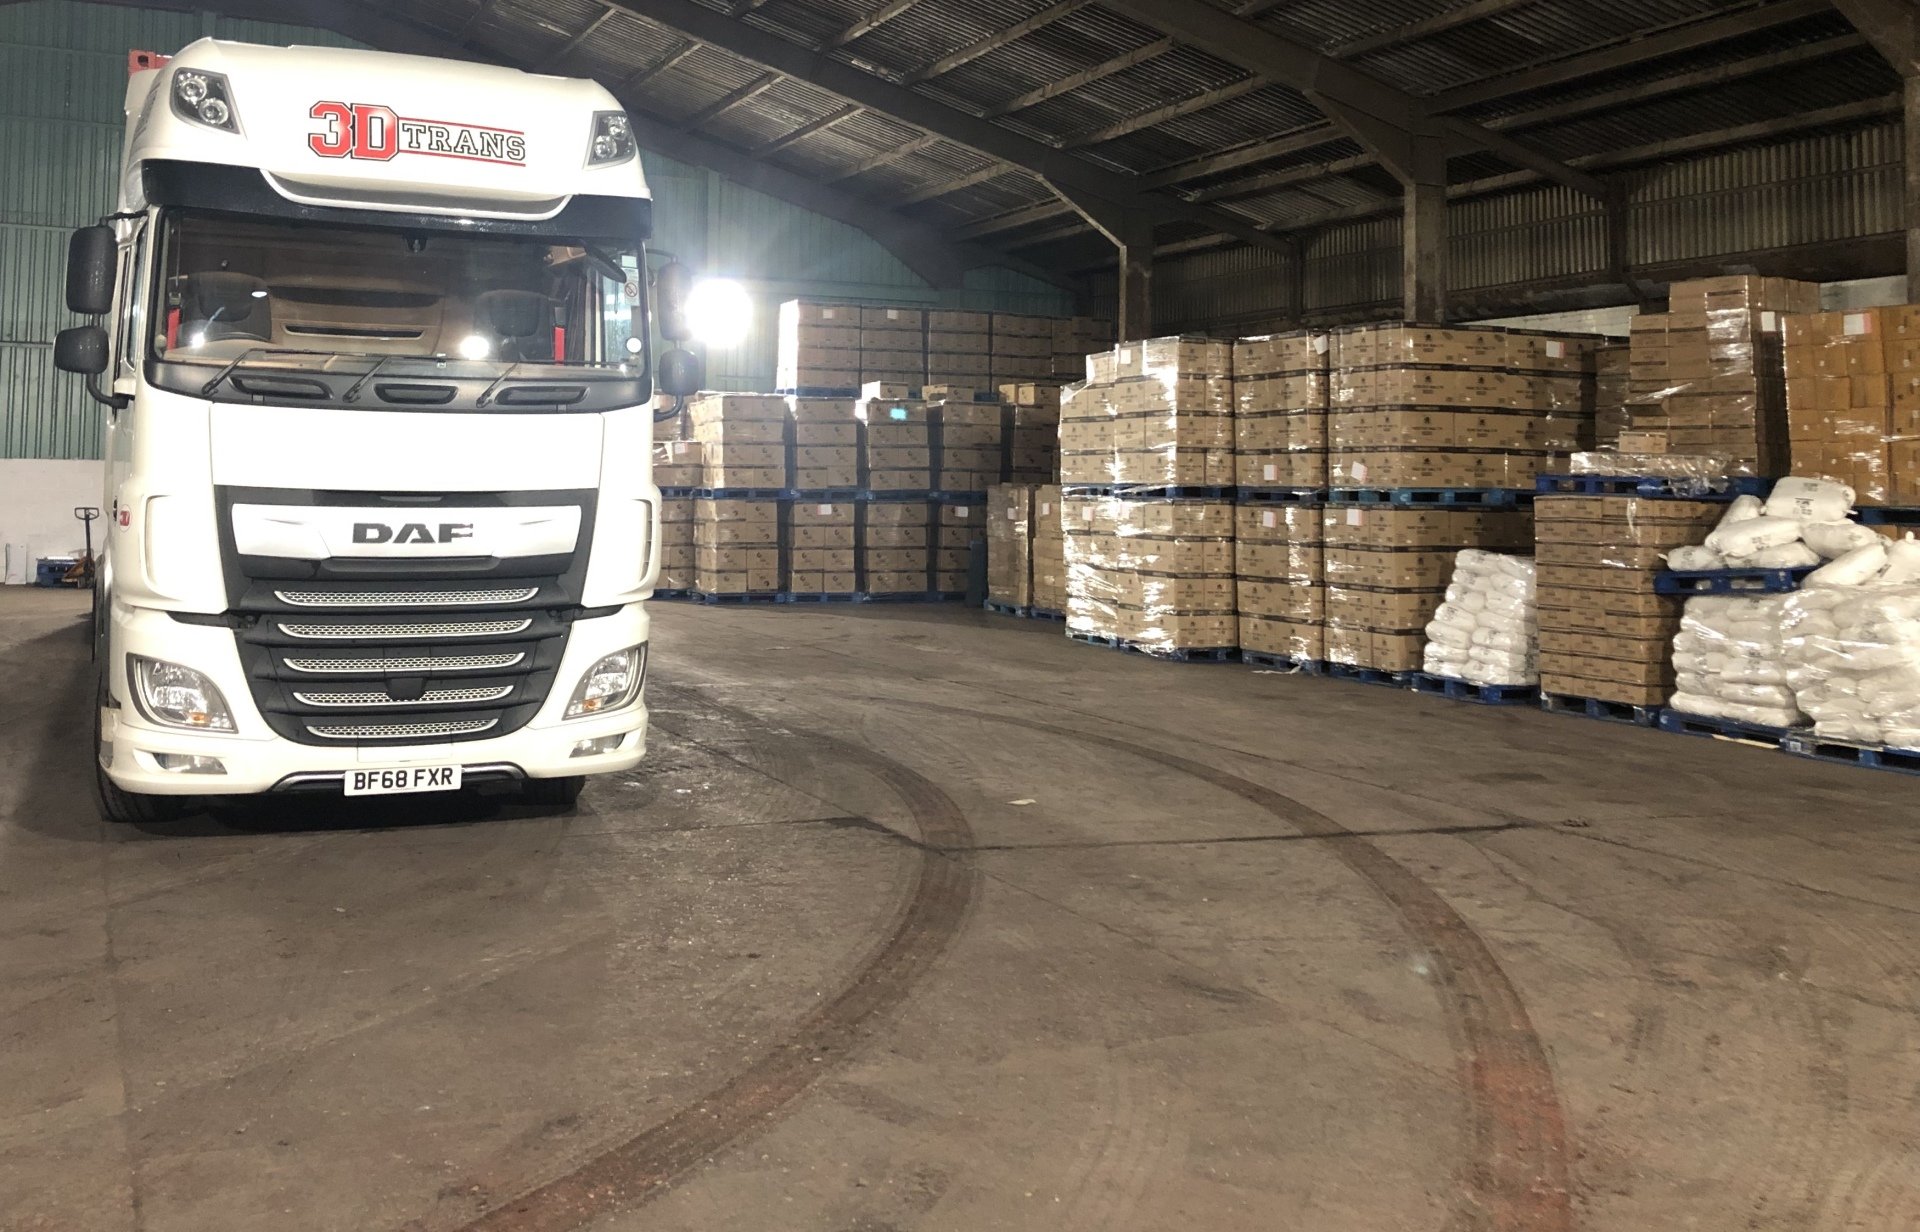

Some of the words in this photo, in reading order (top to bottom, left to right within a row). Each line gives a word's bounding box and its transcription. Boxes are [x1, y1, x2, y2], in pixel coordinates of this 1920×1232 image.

[308, 101, 399, 161] 3D
[402, 123, 526, 161] TRANS
[352, 523, 473, 544] DAF
[354, 770, 408, 790] BF68
[414, 768, 453, 787] FXR
